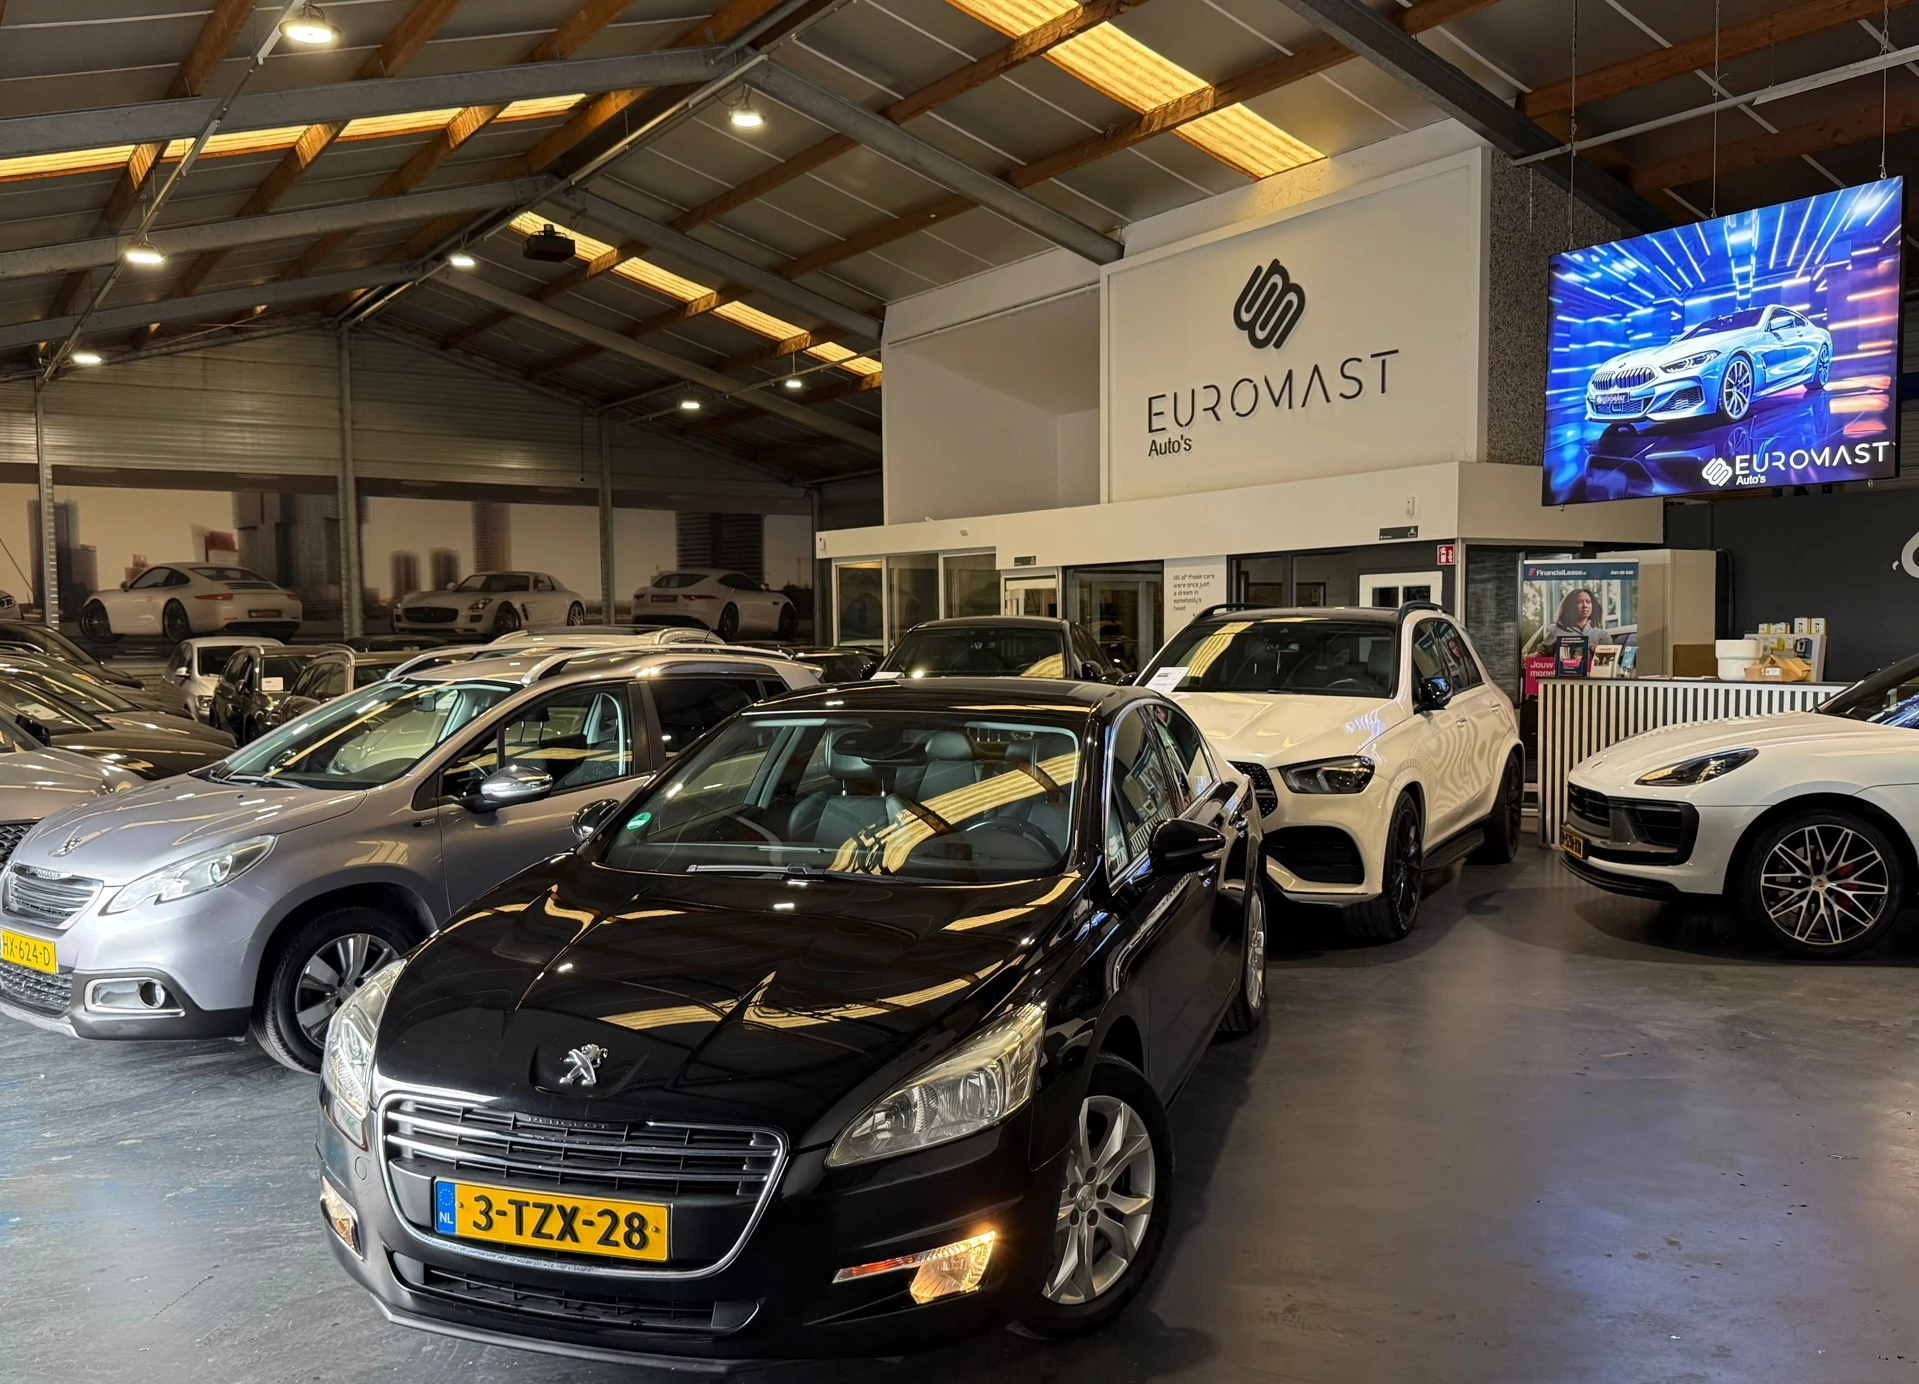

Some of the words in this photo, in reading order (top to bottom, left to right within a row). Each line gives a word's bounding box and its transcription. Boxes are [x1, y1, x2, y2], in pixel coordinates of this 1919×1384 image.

[1147, 348, 1400, 434] EUROMAST
[1148, 434, 1193, 457] Auto's
[1735, 441, 1890, 475] EUROMAST
[1736, 474, 1767, 486] Auto's
[1199, 581, 1210, 589] just
[1530, 660, 1554, 669] Jouw
[2, 933, 51, 967] HX-624-D
[439, 1211, 454, 1225] NL
[472, 1193, 650, 1251] 3-TZX-28
